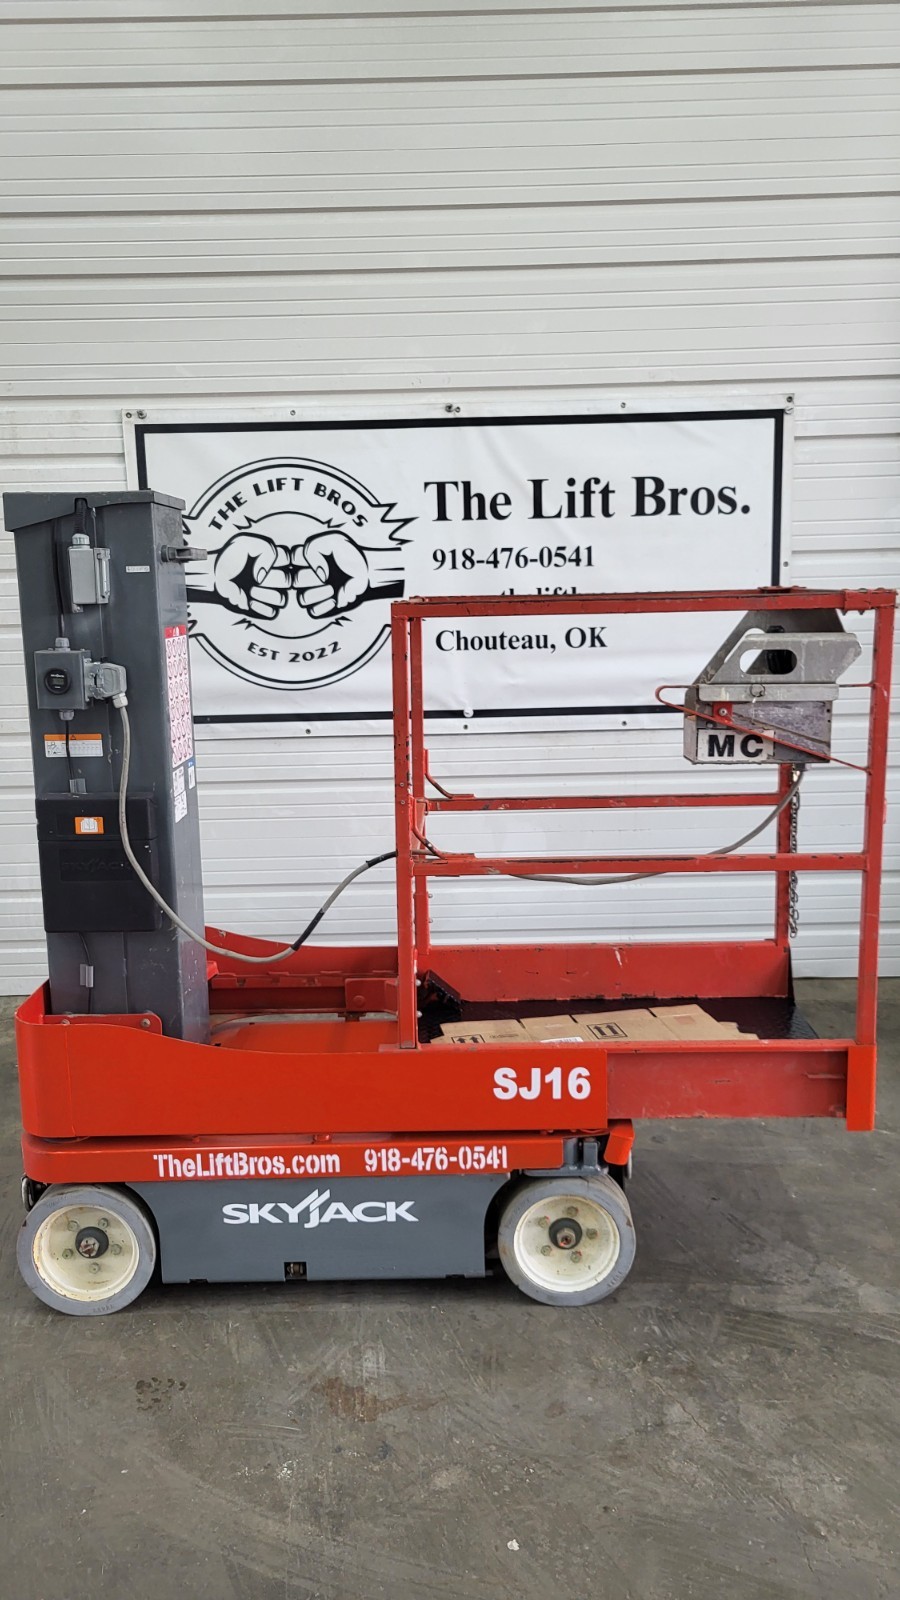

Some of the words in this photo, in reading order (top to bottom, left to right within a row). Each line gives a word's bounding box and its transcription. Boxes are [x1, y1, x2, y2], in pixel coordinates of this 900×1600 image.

[208, 491, 248, 531] THE
[252, 477, 305, 497] LIFT
[313, 482, 368, 528] BROS
[423, 481, 512, 522] The
[527, 477, 616, 519] Lift
[630, 475, 751, 518] Bros.
[432, 545, 595, 570] 918-476-0541
[246, 641, 281, 661] EST
[288, 640, 342, 663] 2022
[435, 629, 557, 653] Chouteau,
[564, 626, 608, 648] OK
[493, 1066, 591, 1100] SJ16
[153, 1152, 341, 1178] TheLiftBros.com
[364, 1145, 509, 1172] 918-476-0541
[222, 1188, 419, 1229] SKYJACK
